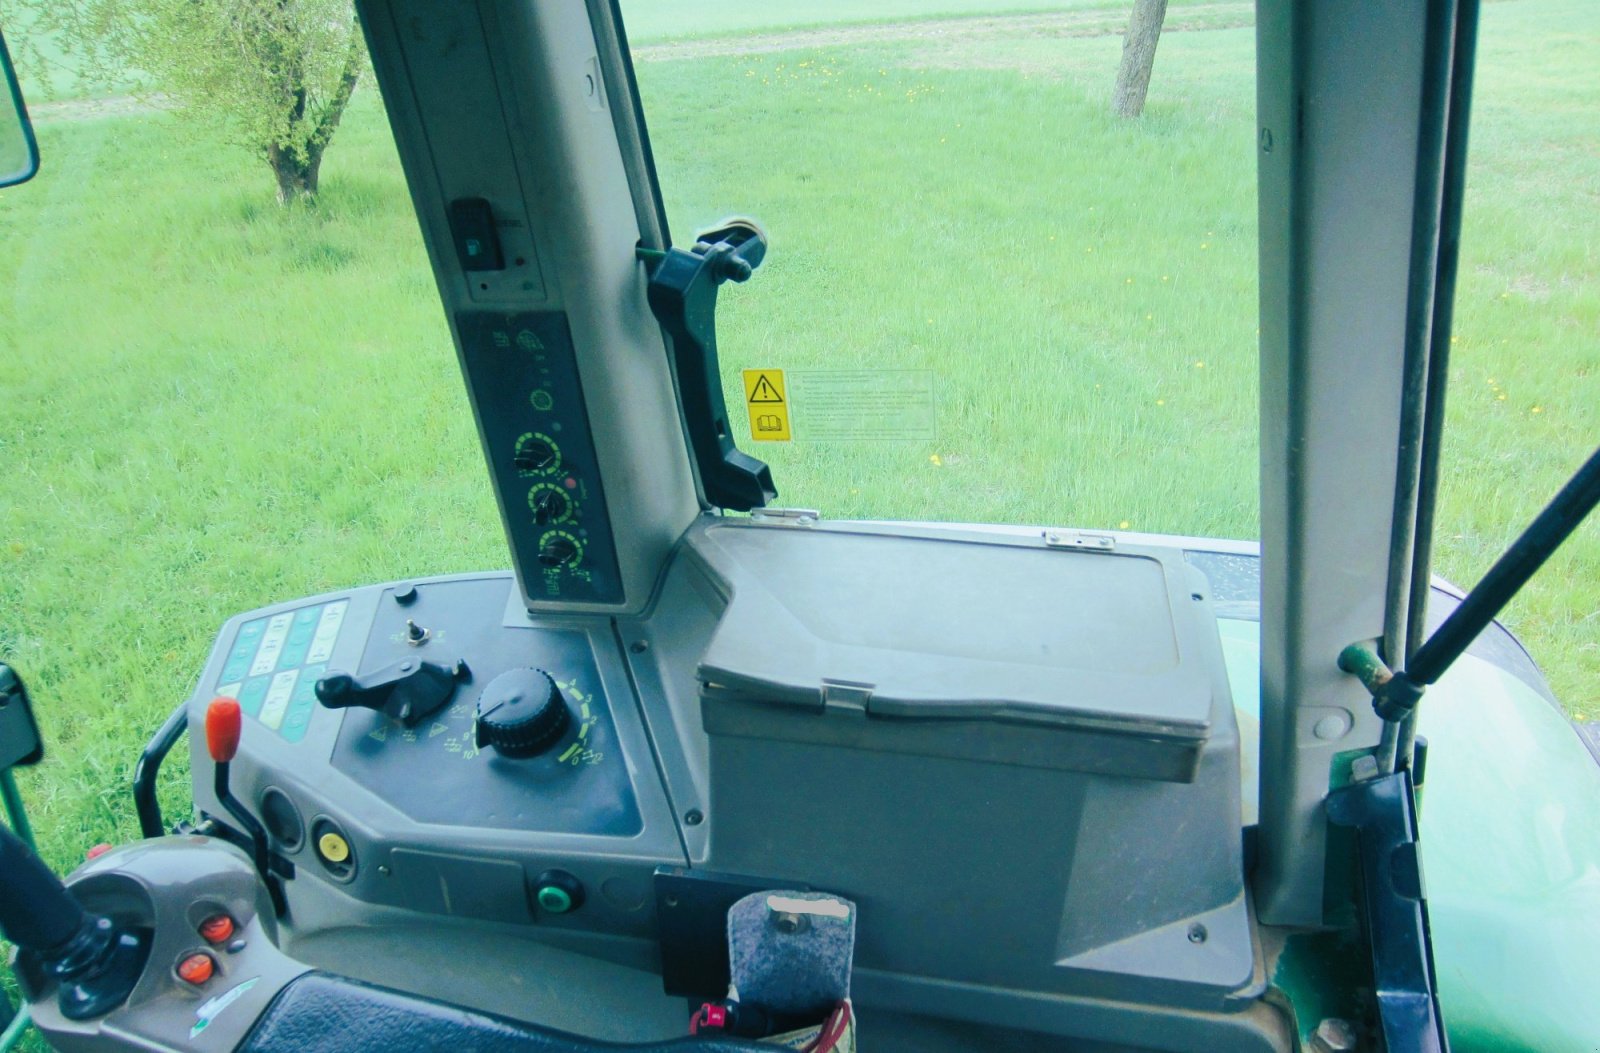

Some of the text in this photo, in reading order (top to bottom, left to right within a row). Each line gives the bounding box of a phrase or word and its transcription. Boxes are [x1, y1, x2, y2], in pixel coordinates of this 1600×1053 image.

[568, 678, 577, 687] 4
[584, 693, 593, 703] 3
[589, 715, 598, 725] 2
[463, 750, 474, 760] 10
[571, 756, 579, 766] 0
